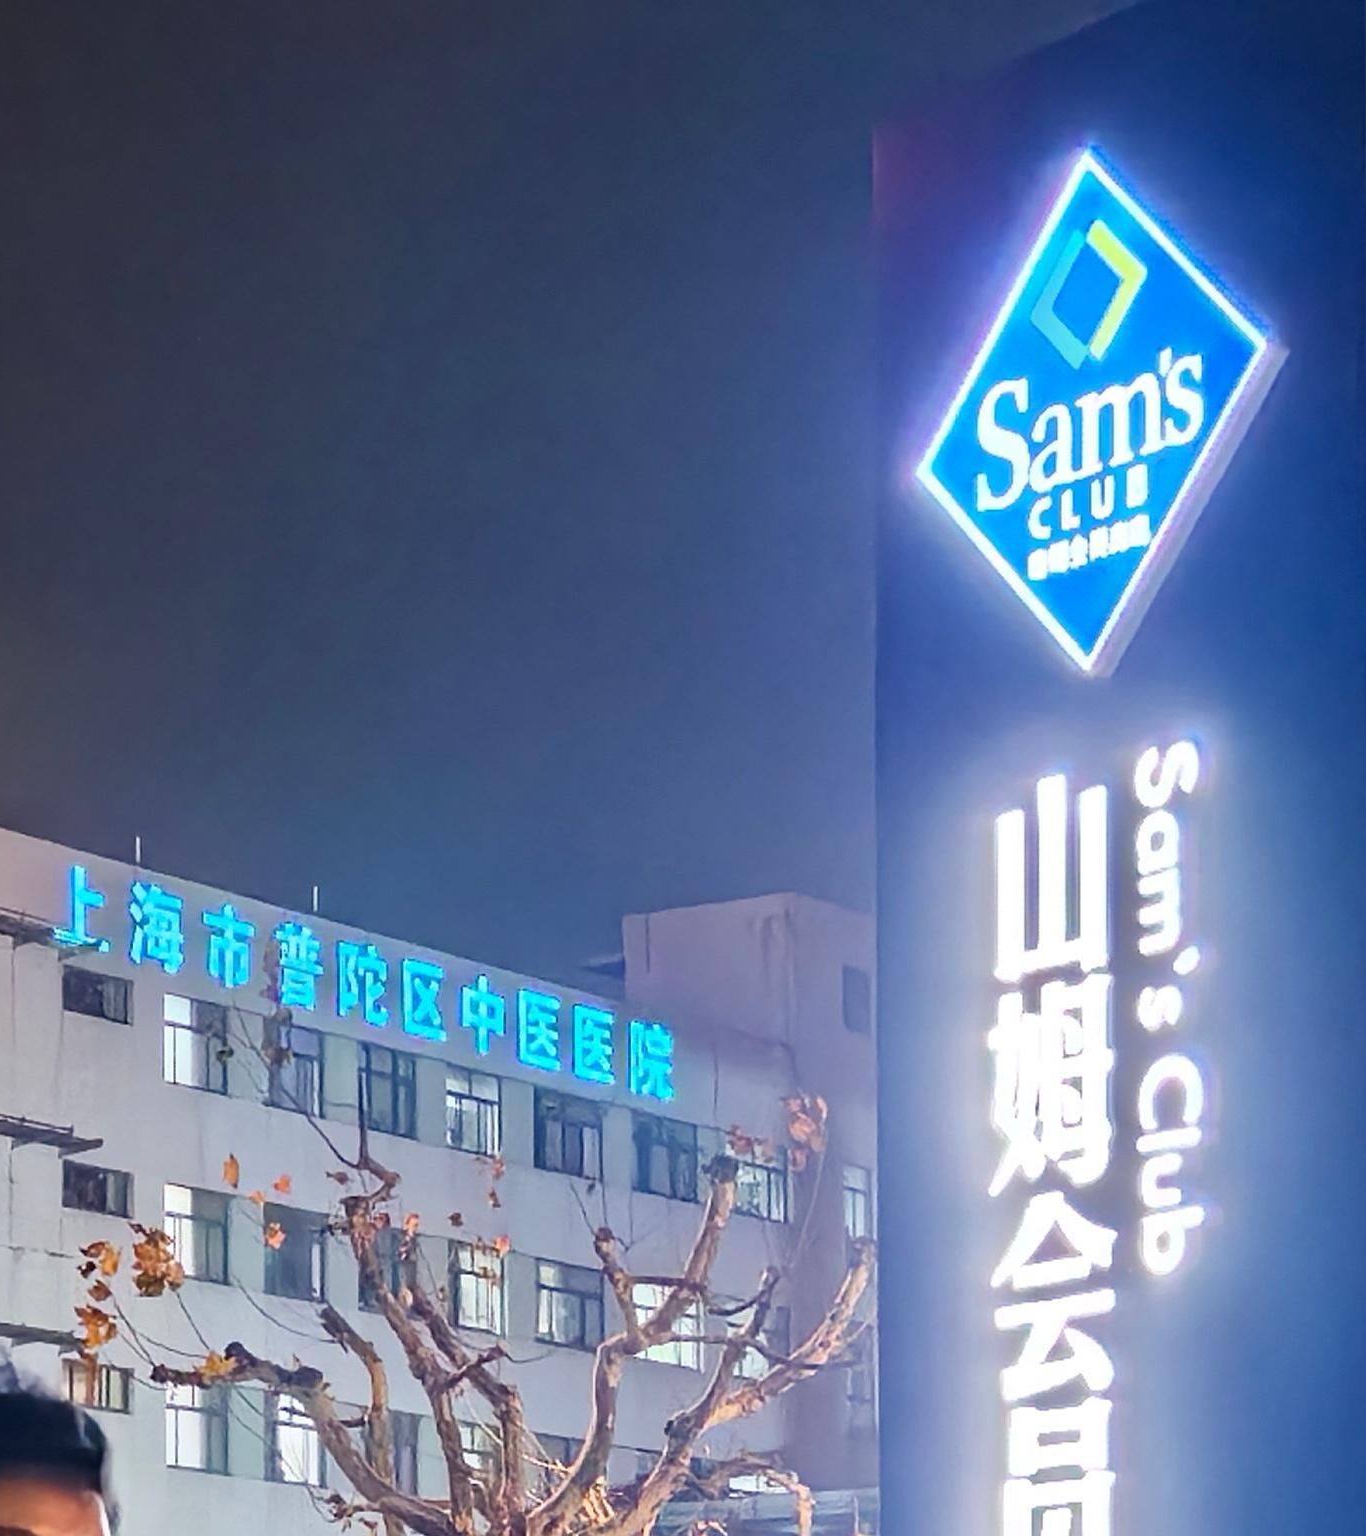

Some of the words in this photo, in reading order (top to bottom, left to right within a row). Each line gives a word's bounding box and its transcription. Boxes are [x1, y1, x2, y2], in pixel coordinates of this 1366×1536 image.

[975, 347, 1204, 512] Sam's
[52, 864, 673, 1100] 上海市普陀区中医医院
[1135, 740, 1200, 1032] Sam's
[1136, 1054, 1205, 1276] Club
